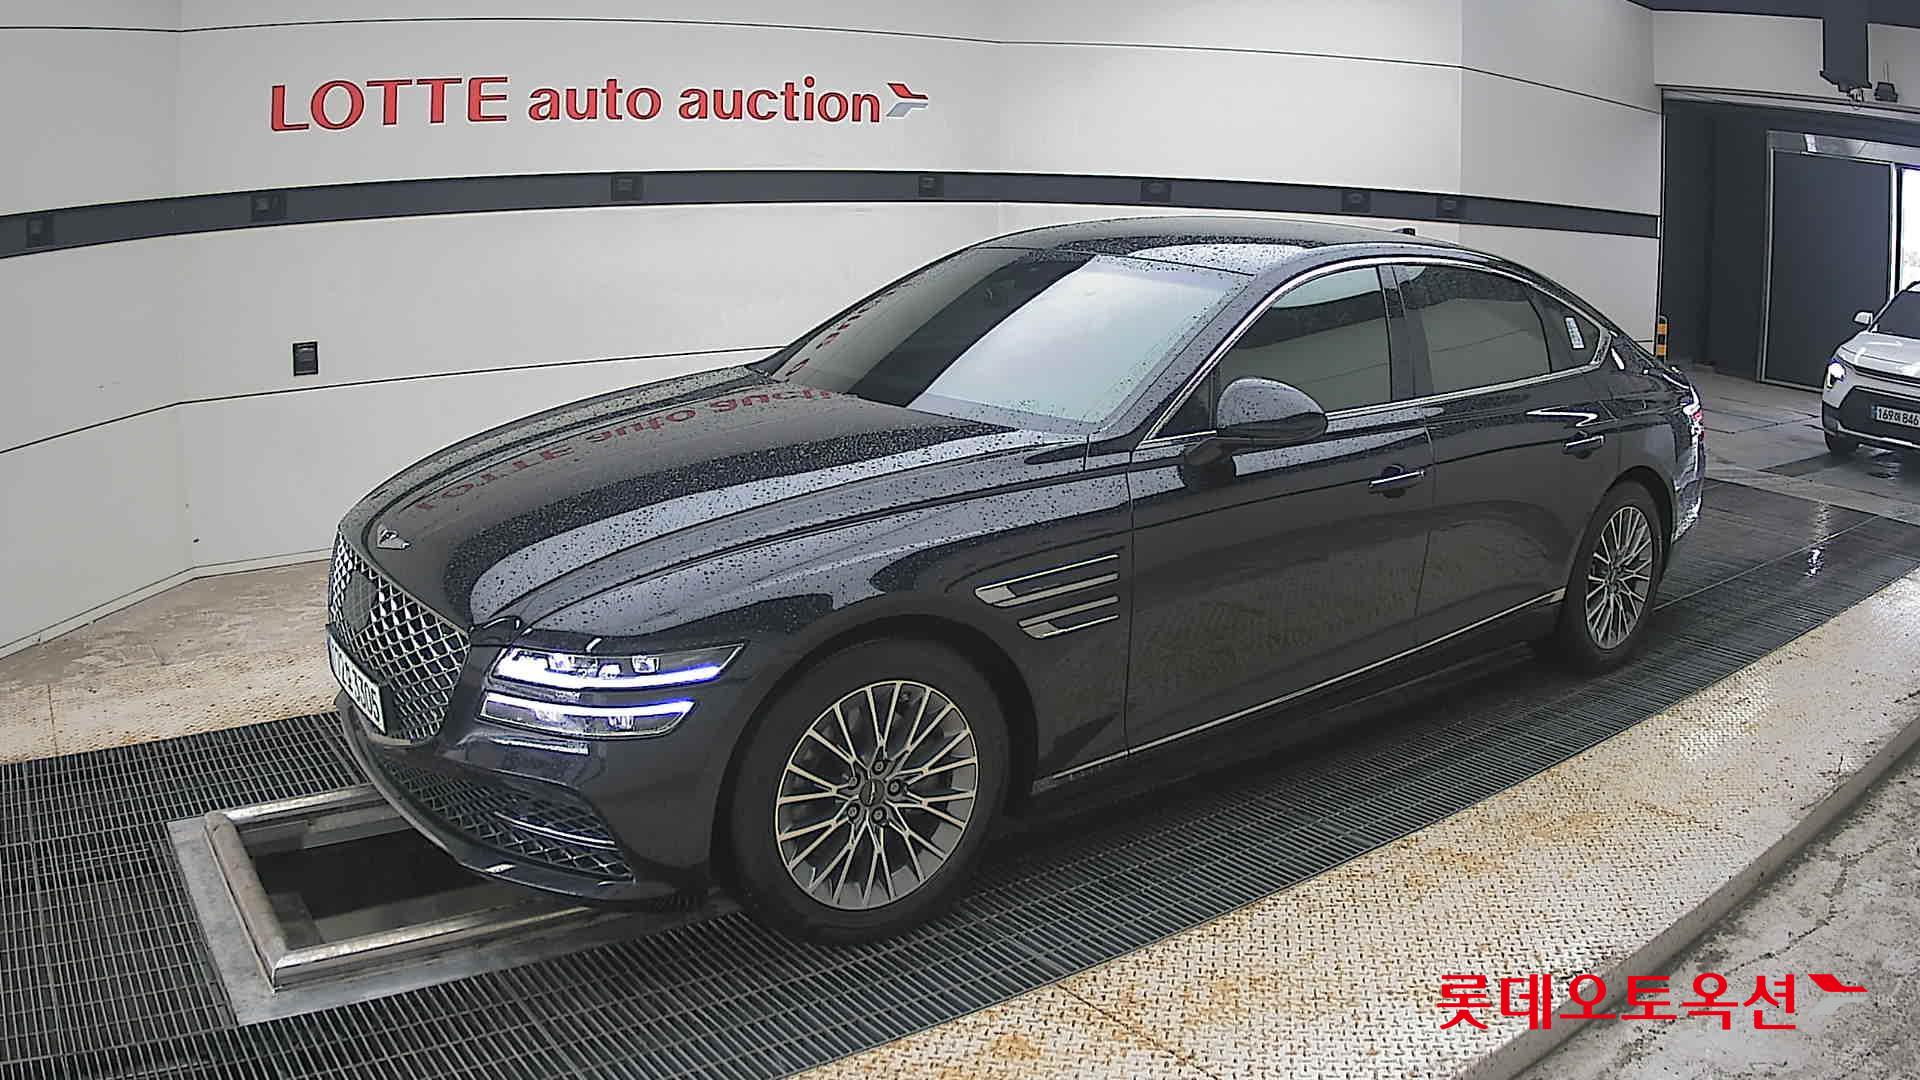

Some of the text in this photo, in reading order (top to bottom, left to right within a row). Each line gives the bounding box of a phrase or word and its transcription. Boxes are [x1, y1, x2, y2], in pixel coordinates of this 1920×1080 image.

[271, 75, 881, 132] LOTTE auto auction
